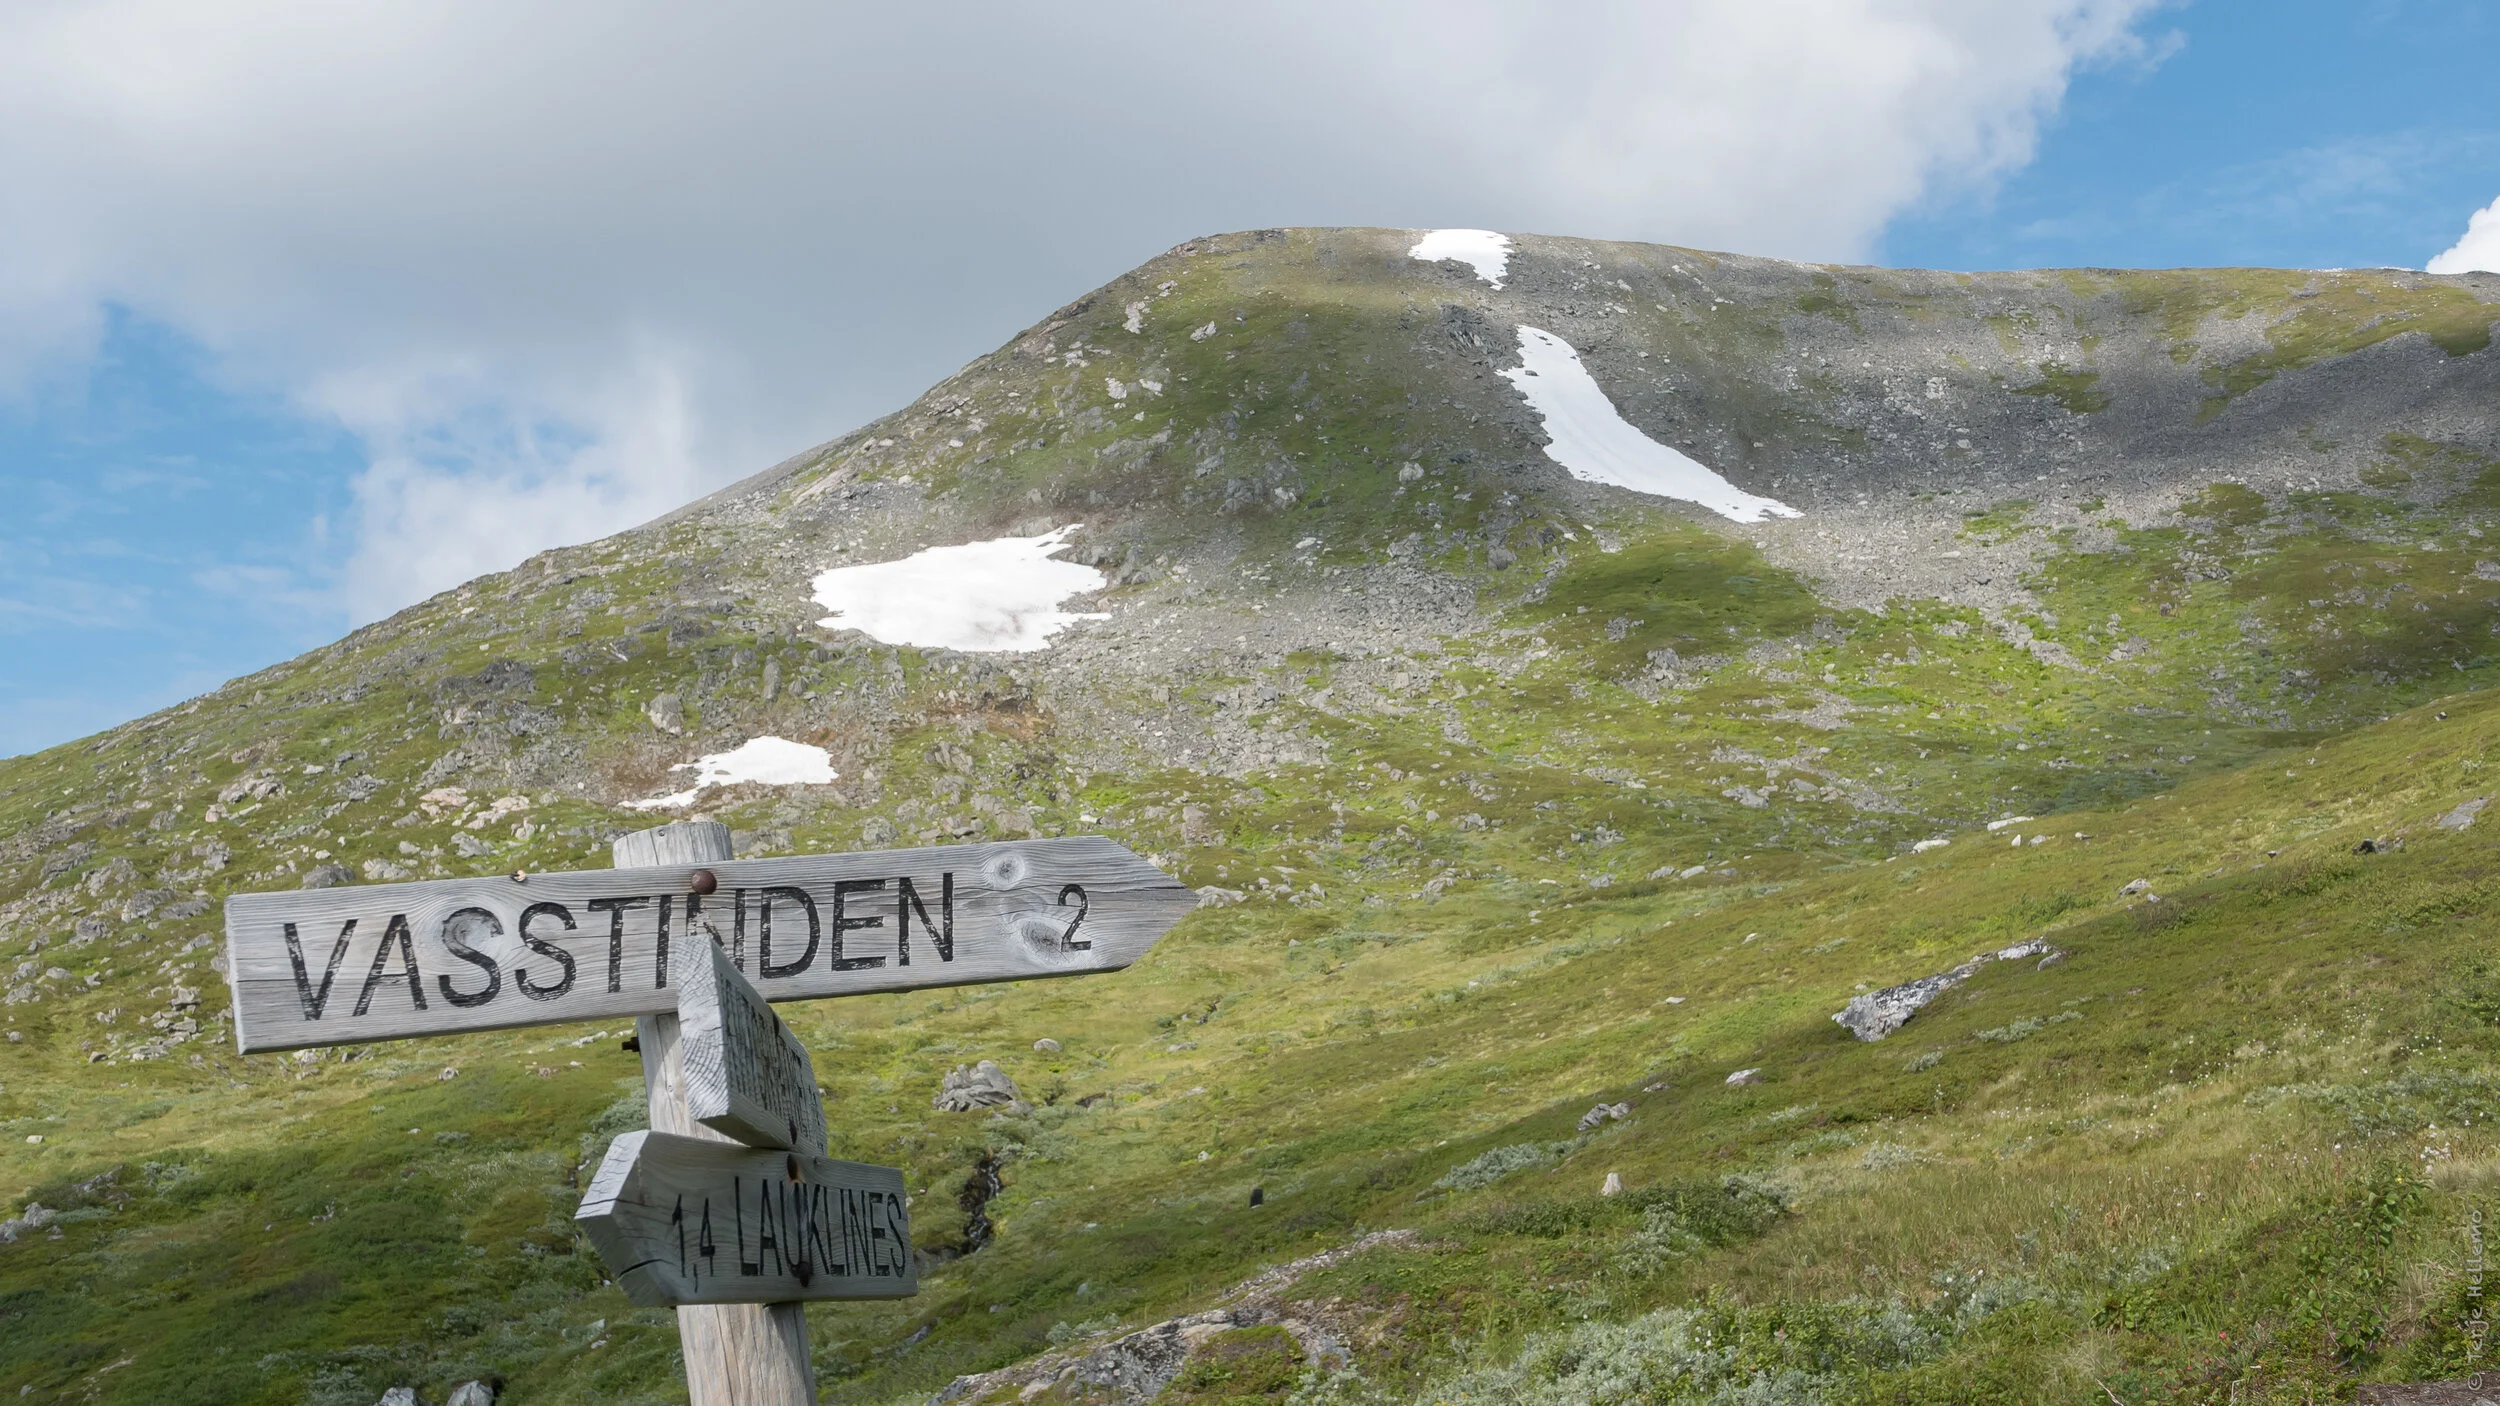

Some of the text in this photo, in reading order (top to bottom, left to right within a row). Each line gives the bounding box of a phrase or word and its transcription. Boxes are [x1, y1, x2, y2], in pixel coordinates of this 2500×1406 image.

[283, 873, 1092, 1021] VASSTINDEN 2
[734, 1176, 907, 1278] LAUKLINES
